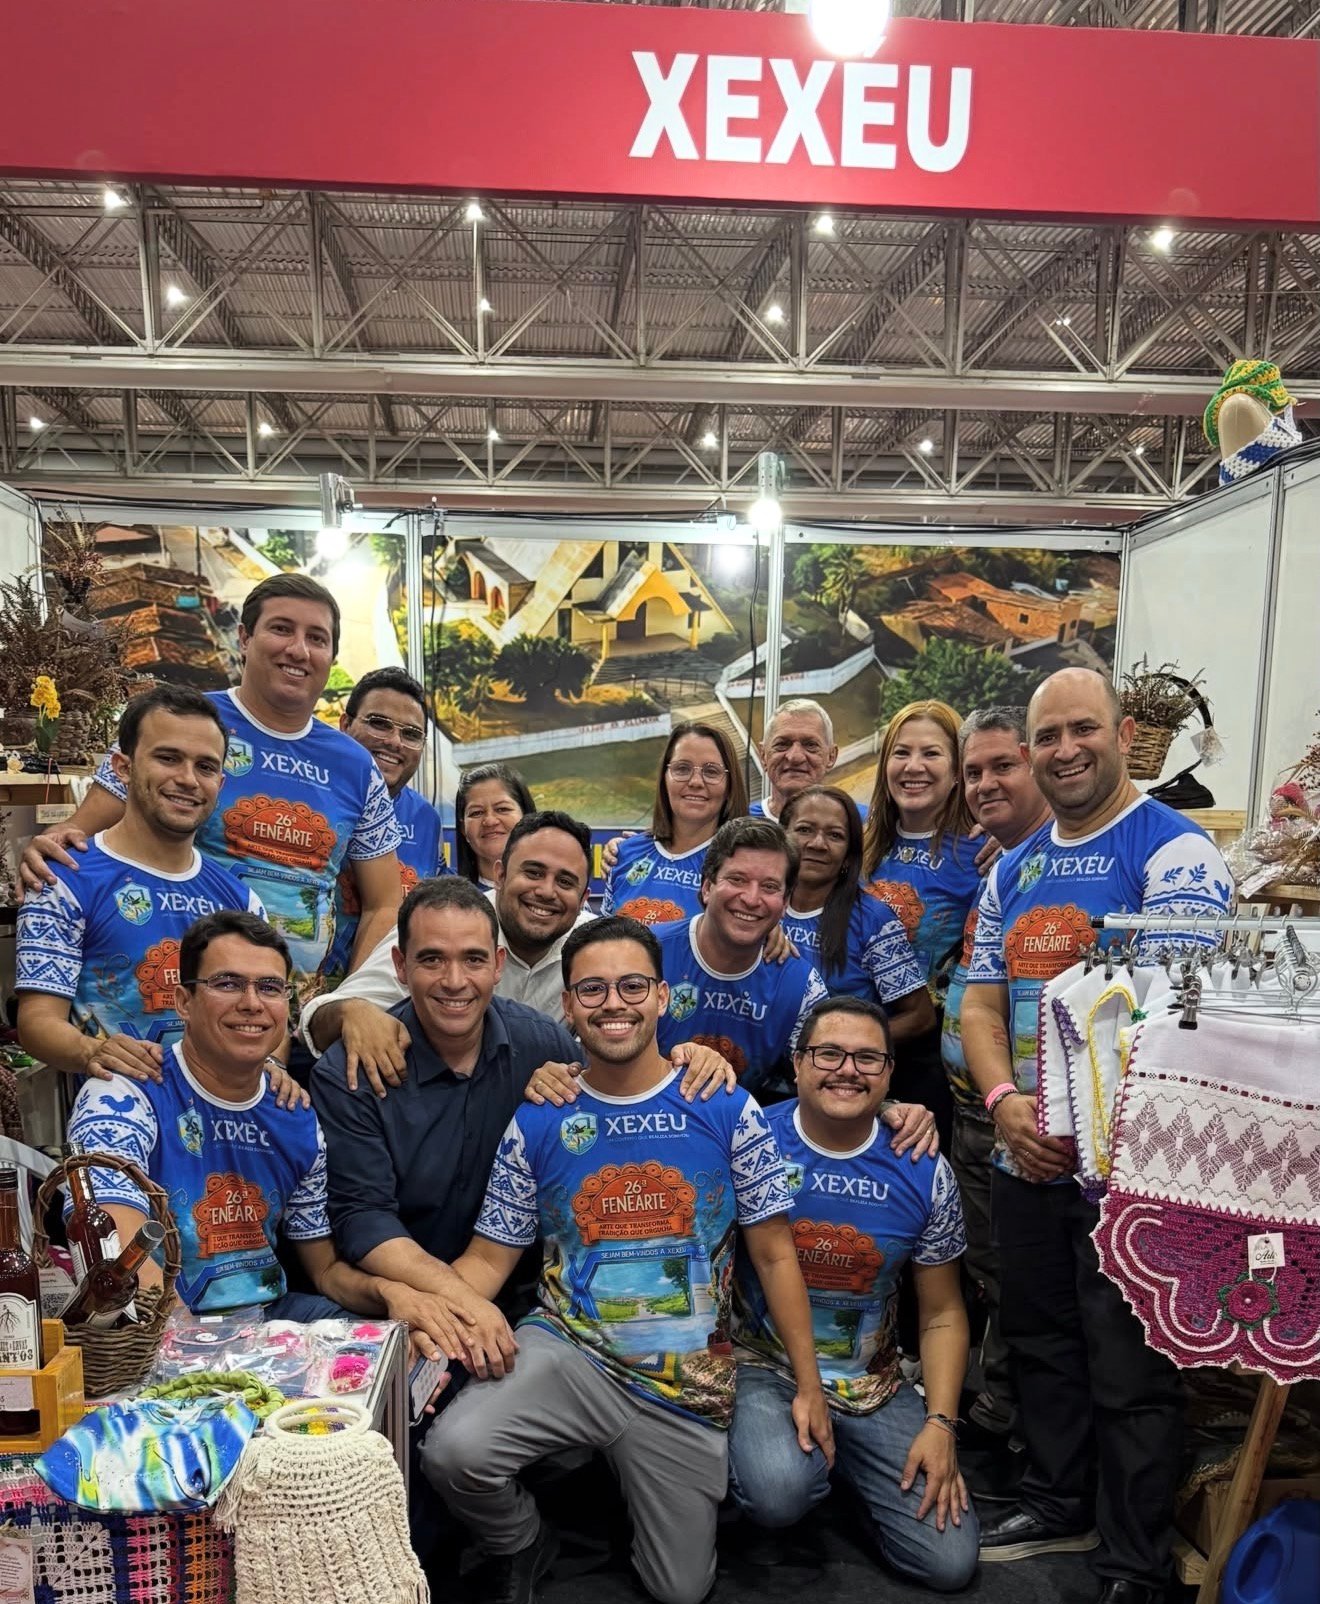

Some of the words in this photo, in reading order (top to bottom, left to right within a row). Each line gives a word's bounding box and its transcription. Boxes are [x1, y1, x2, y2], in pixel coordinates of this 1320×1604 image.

[628, 36, 972, 173] XEXÉU
[260, 751, 329, 785] XEXÉU
[253, 821, 314, 848] FENEARTE
[1046, 852, 1115, 877] XEXÉU
[1023, 934, 1073, 953] FENEARTE
[703, 991, 768, 1020] XEXÉU
[604, 1109, 688, 1137] XEXÉU
[226, 1190, 248, 1205] 26ª
[625, 1179, 647, 1195] 26ª
[810, 1172, 889, 1201] XEXÉU
[602, 1192, 667, 1215] FENEARTE
[796, 1248, 856, 1269] ENEARTE
